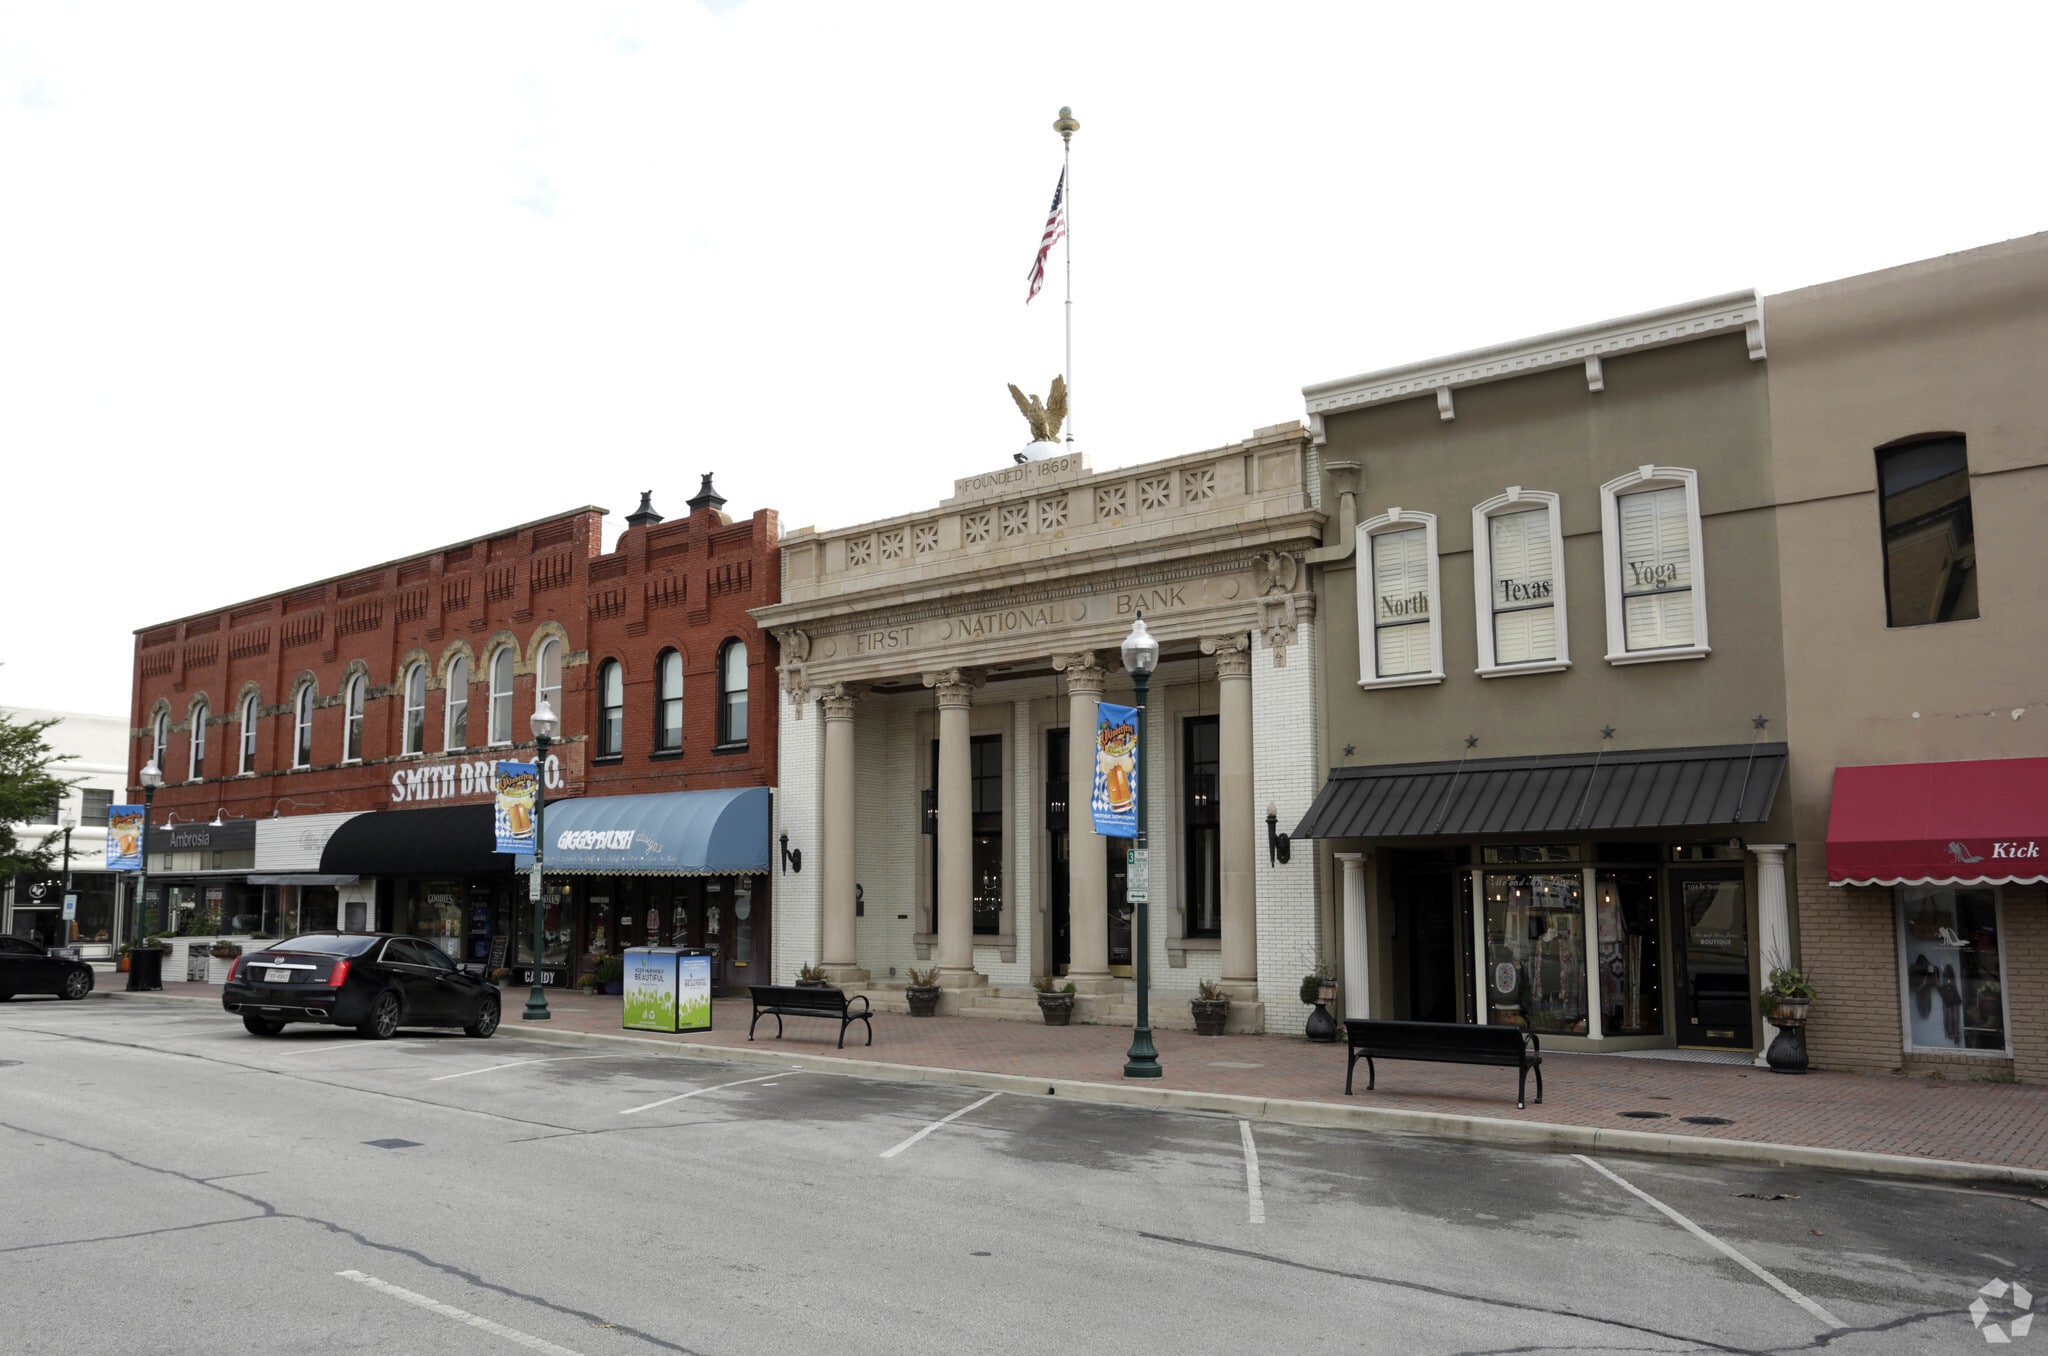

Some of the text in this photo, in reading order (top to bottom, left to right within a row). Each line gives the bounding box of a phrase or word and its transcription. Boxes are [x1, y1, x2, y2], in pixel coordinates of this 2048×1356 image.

[965, 459, 1069, 492] FOUNDED 1869
[1628, 560, 1678, 589] Yoga
[1500, 578, 1550, 602] Texas
[1381, 591, 1429, 618] North
[856, 586, 1186, 652] FIRST NATIONAL BANK
[391, 764, 456, 802] SMITH
[169, 830, 210, 848] Ambrosia
[1991, 841, 2040, 859] Kick
[1128, 851, 1134, 863] 3
[427, 894, 455, 904] GOODIES
[634, 973, 664, 982] BEAUTIFUL
